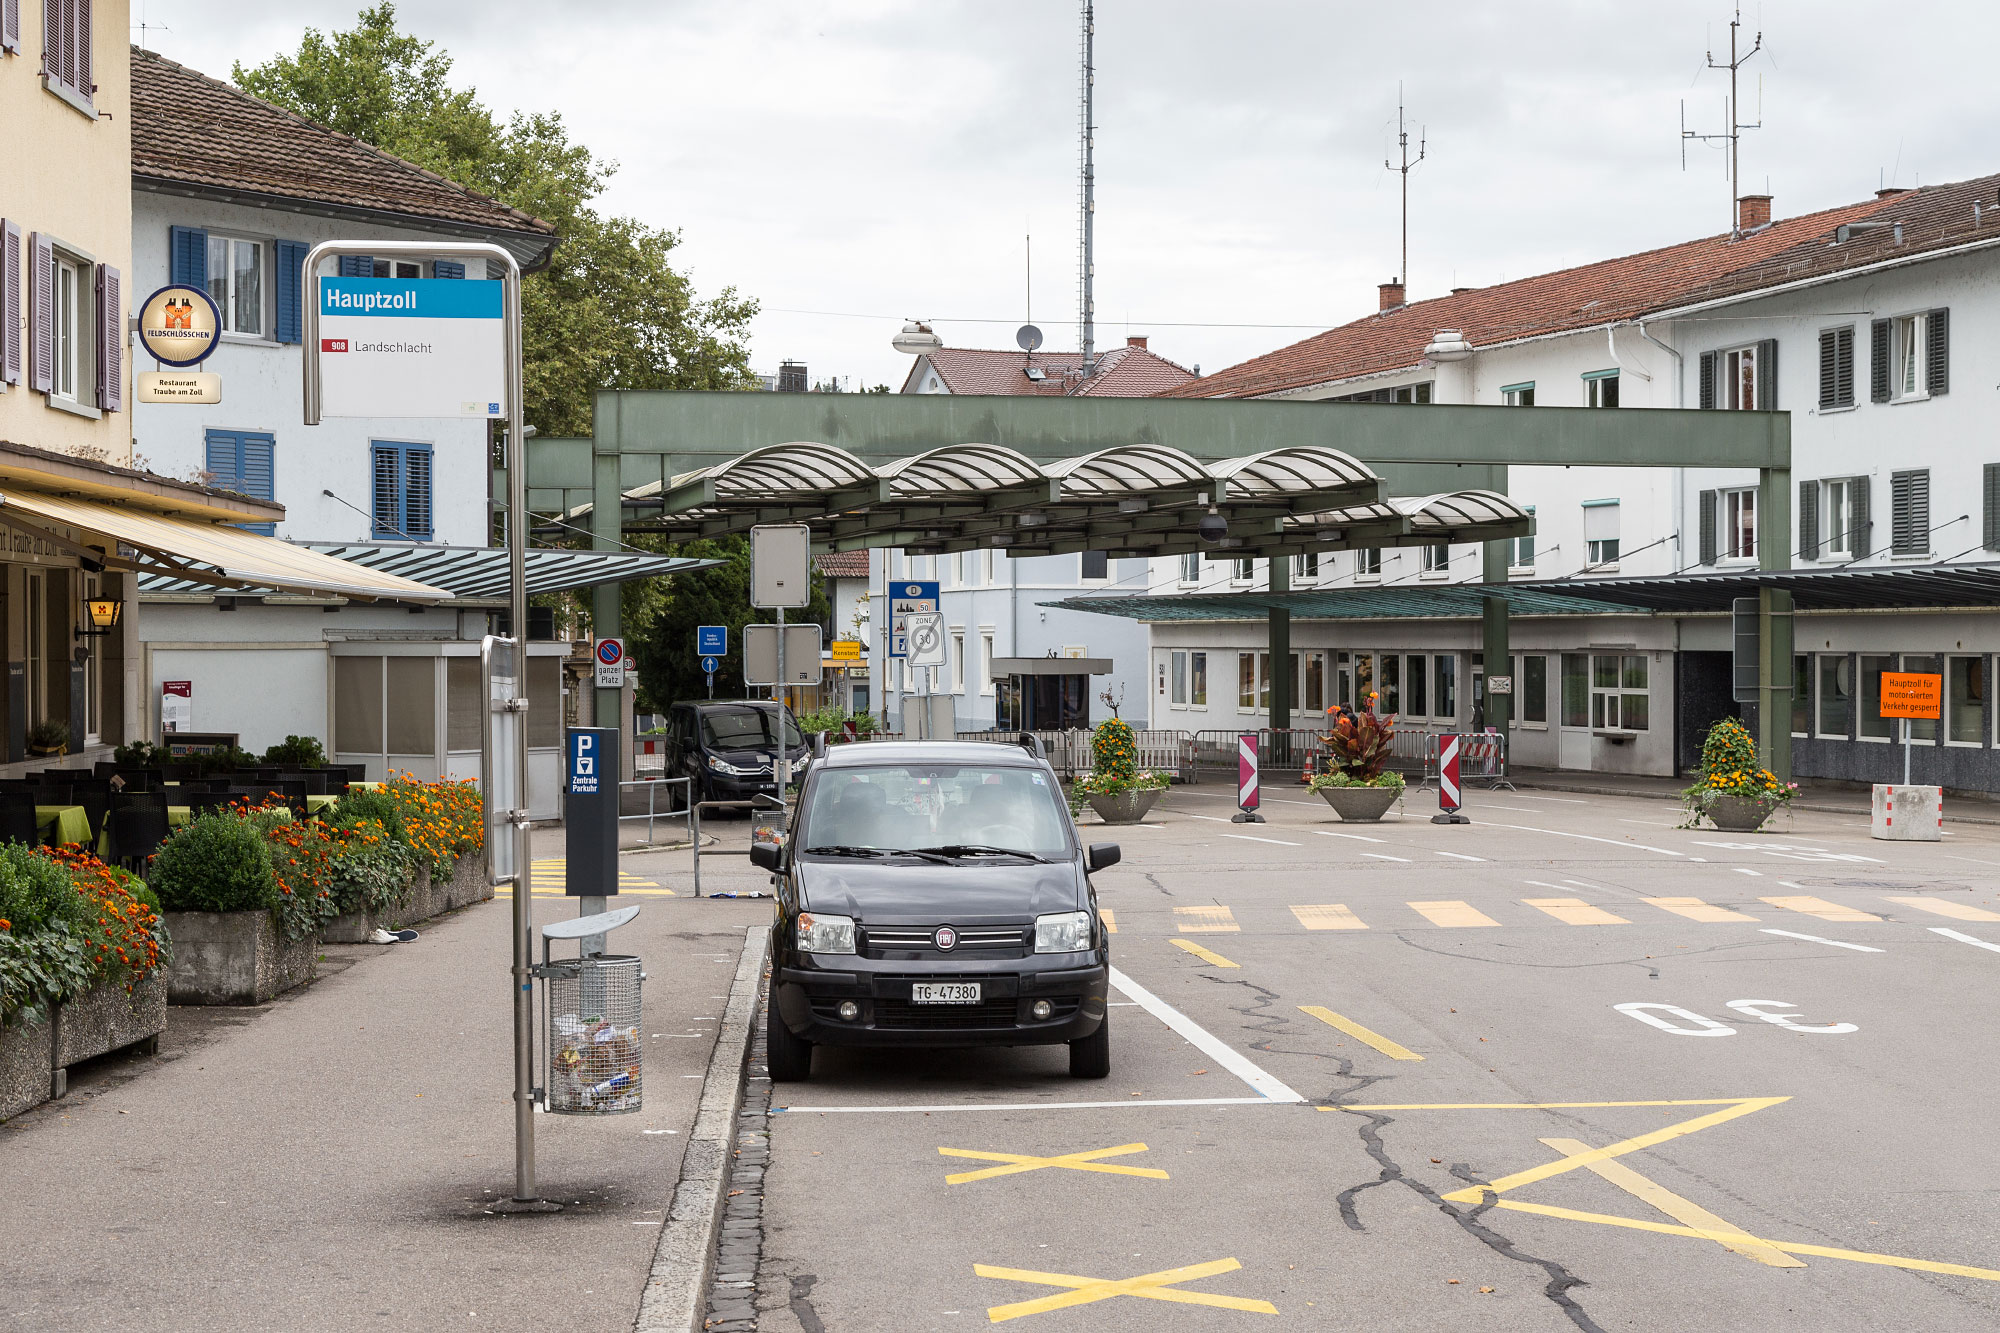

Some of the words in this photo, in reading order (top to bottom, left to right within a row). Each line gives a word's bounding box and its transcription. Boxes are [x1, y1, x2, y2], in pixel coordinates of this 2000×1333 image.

[327, 288, 417, 312] Hauptzoll
[147, 329, 210, 339] FELDSCHLÖSSCHEN
[331, 341, 346, 351] 908
[355, 341, 432, 354] Landschlacht
[8, 525, 31, 554] Traube
[910, 586, 917, 594] D
[920, 604, 929, 612] 50
[915, 617, 933, 625] ZONE
[919, 634, 931, 645] 30
[598, 667, 622, 675] ganzer
[601, 676, 619, 684] Platz
[1889, 679, 1922, 689] Hauptzoll
[1923, 680, 1933, 688] für
[1888, 691, 1934, 699] motorisierten
[1882, 702, 1909, 710] Verkehr
[1909, 704, 1938, 713] gesperrt
[172, 746, 187, 754] TOTO
[577, 735, 593, 757] P
[572, 776, 598, 785] Zentrale
[572, 784, 598, 793] Parkuhr
[939, 934, 952, 944] FIAT
[1613, 999, 1860, 1037] 30
